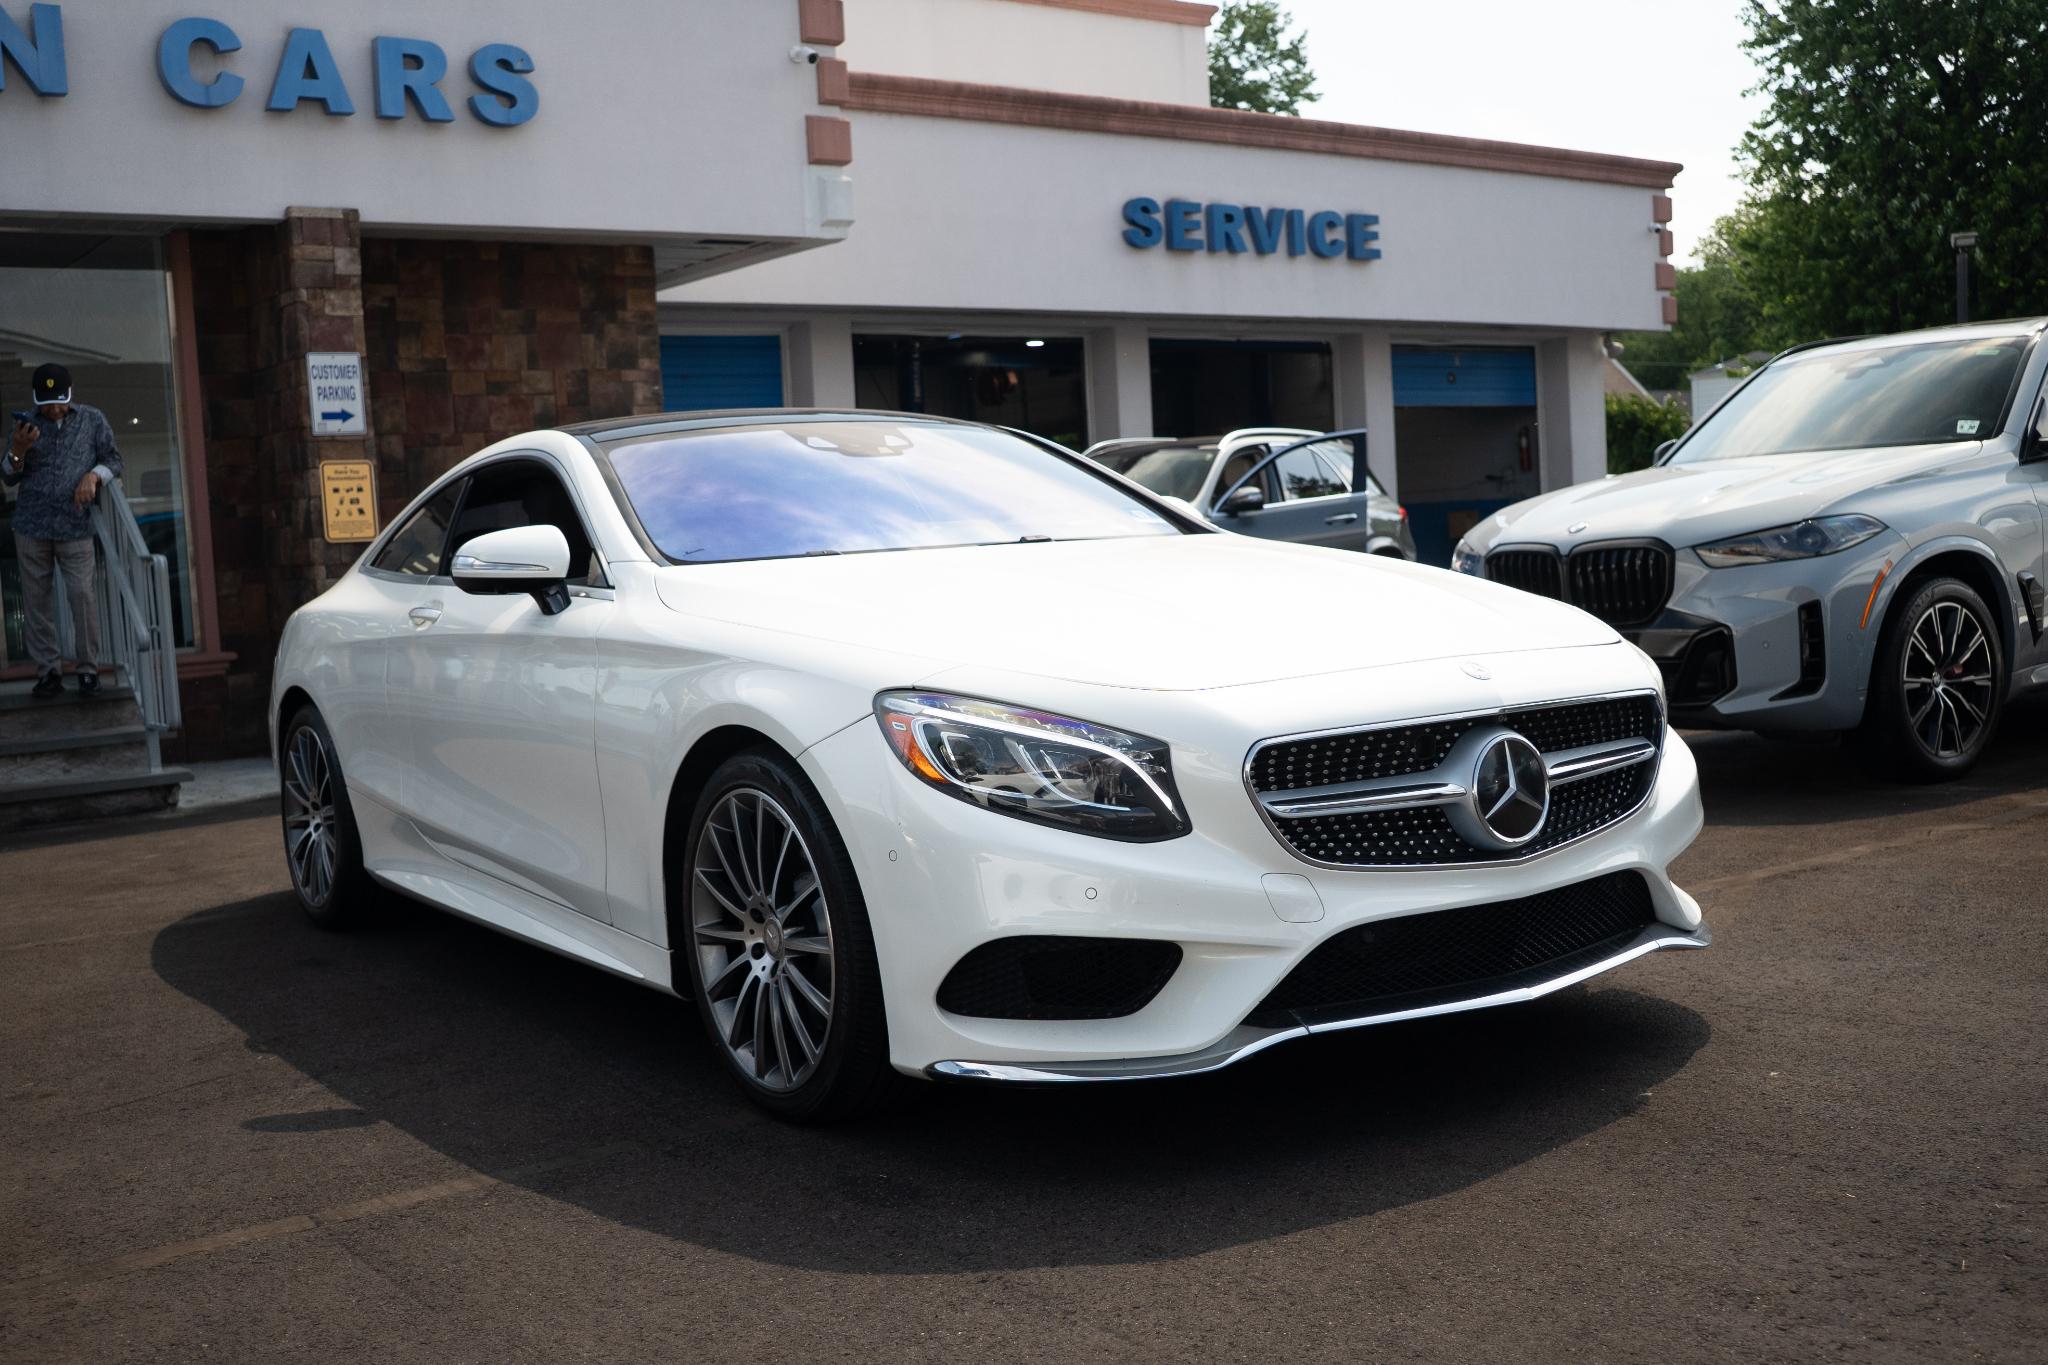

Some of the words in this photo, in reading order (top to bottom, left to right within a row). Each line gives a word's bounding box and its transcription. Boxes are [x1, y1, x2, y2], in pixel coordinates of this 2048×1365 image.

[157, 17, 539, 127] CARS
[1122, 197, 1382, 260] SERVICE
[311, 364, 359, 380] CUSTOMER
[317, 385, 356, 401] PARKING
